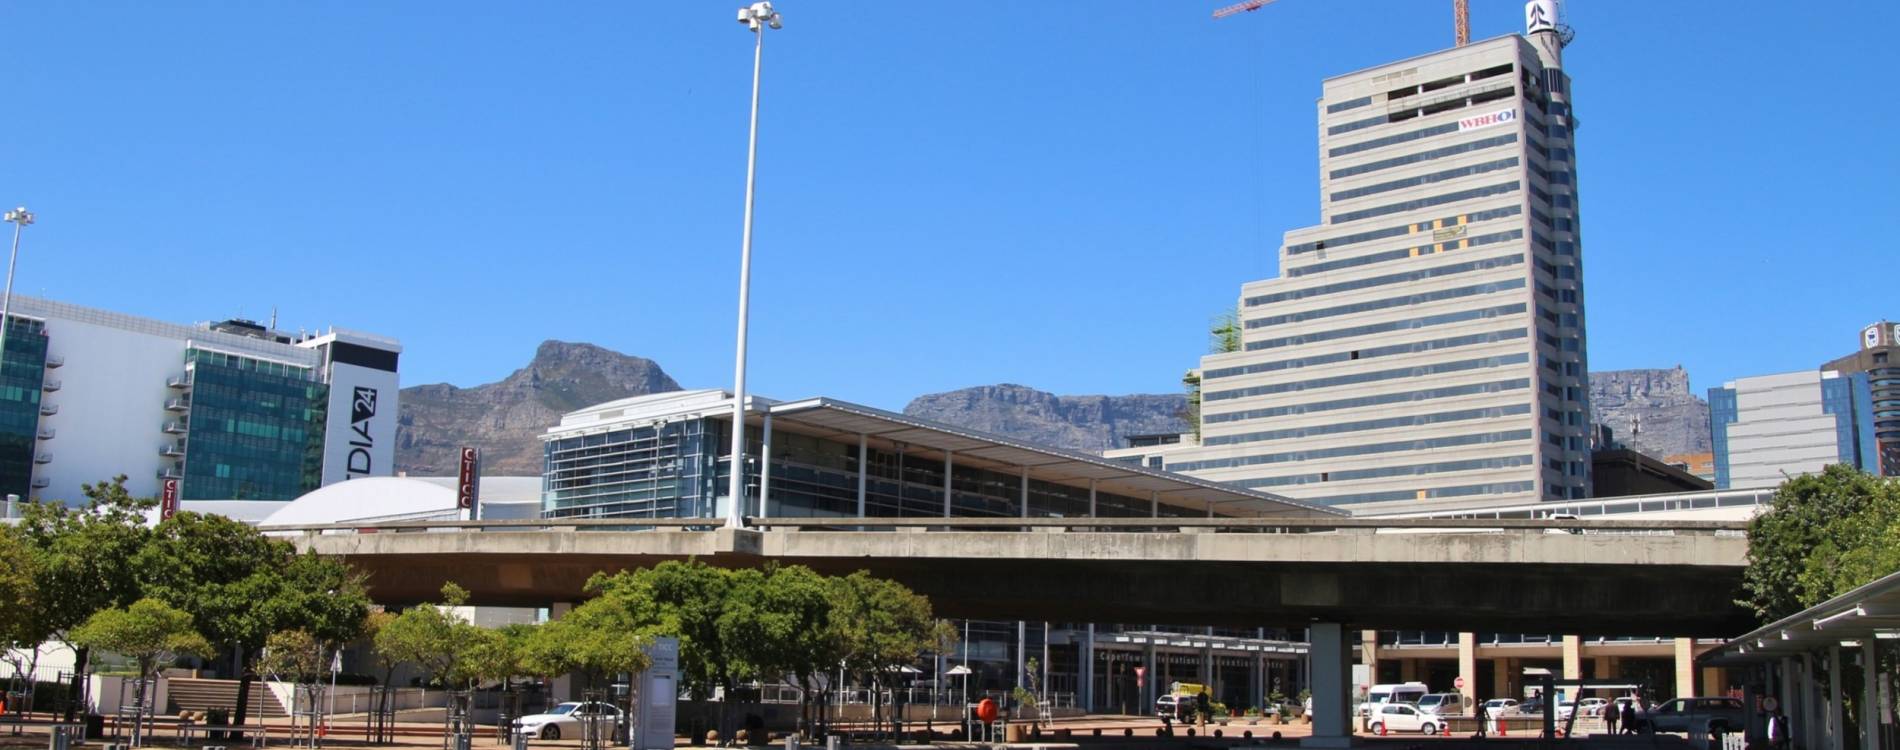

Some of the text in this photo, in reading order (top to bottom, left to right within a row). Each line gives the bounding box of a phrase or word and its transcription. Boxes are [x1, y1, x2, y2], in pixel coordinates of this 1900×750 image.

[1460, 111, 1511, 129] WBHO
[346, 386, 377, 480] DIA24
[164, 480, 174, 521] CTIC
[461, 448, 473, 507] CTICC
